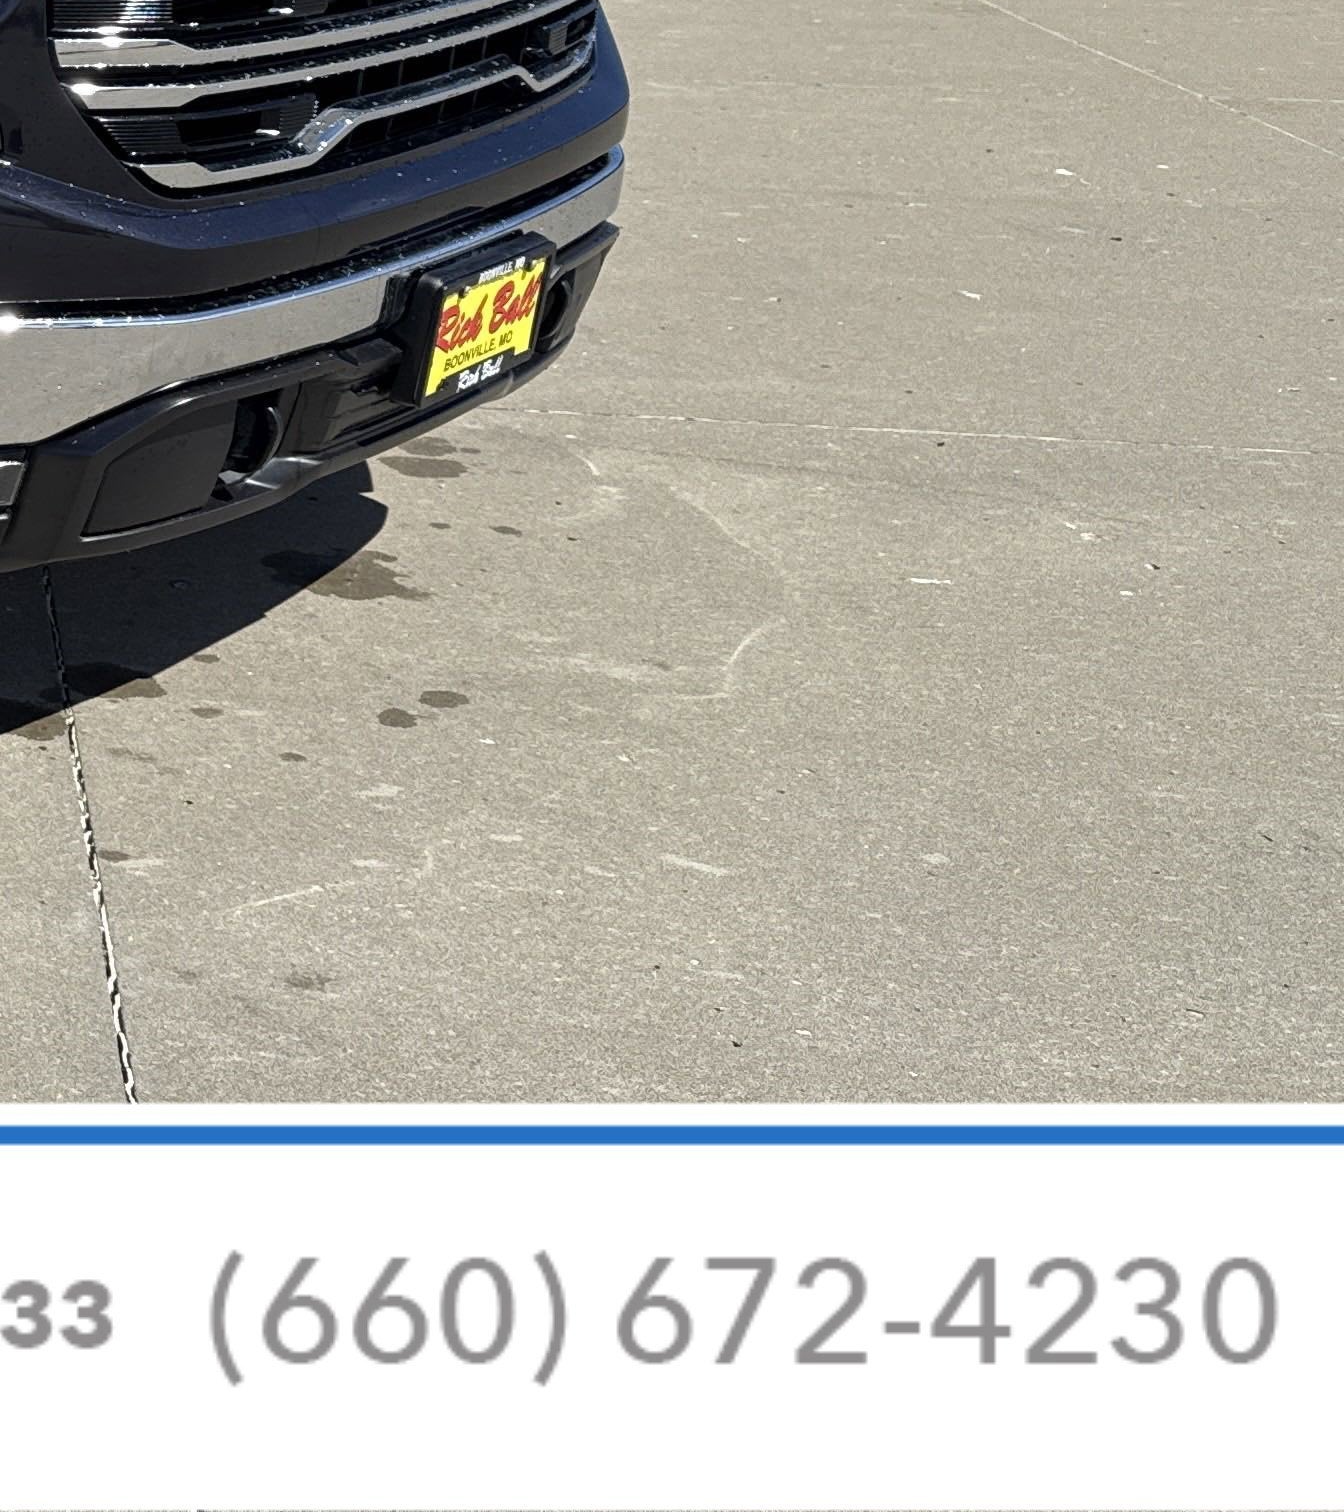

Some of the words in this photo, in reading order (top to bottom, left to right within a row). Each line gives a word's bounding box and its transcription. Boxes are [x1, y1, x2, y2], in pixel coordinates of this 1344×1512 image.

[436, 294, 488, 353] Rick
[489, 272, 544, 334] Ball
[499, 330, 513, 347] MO
